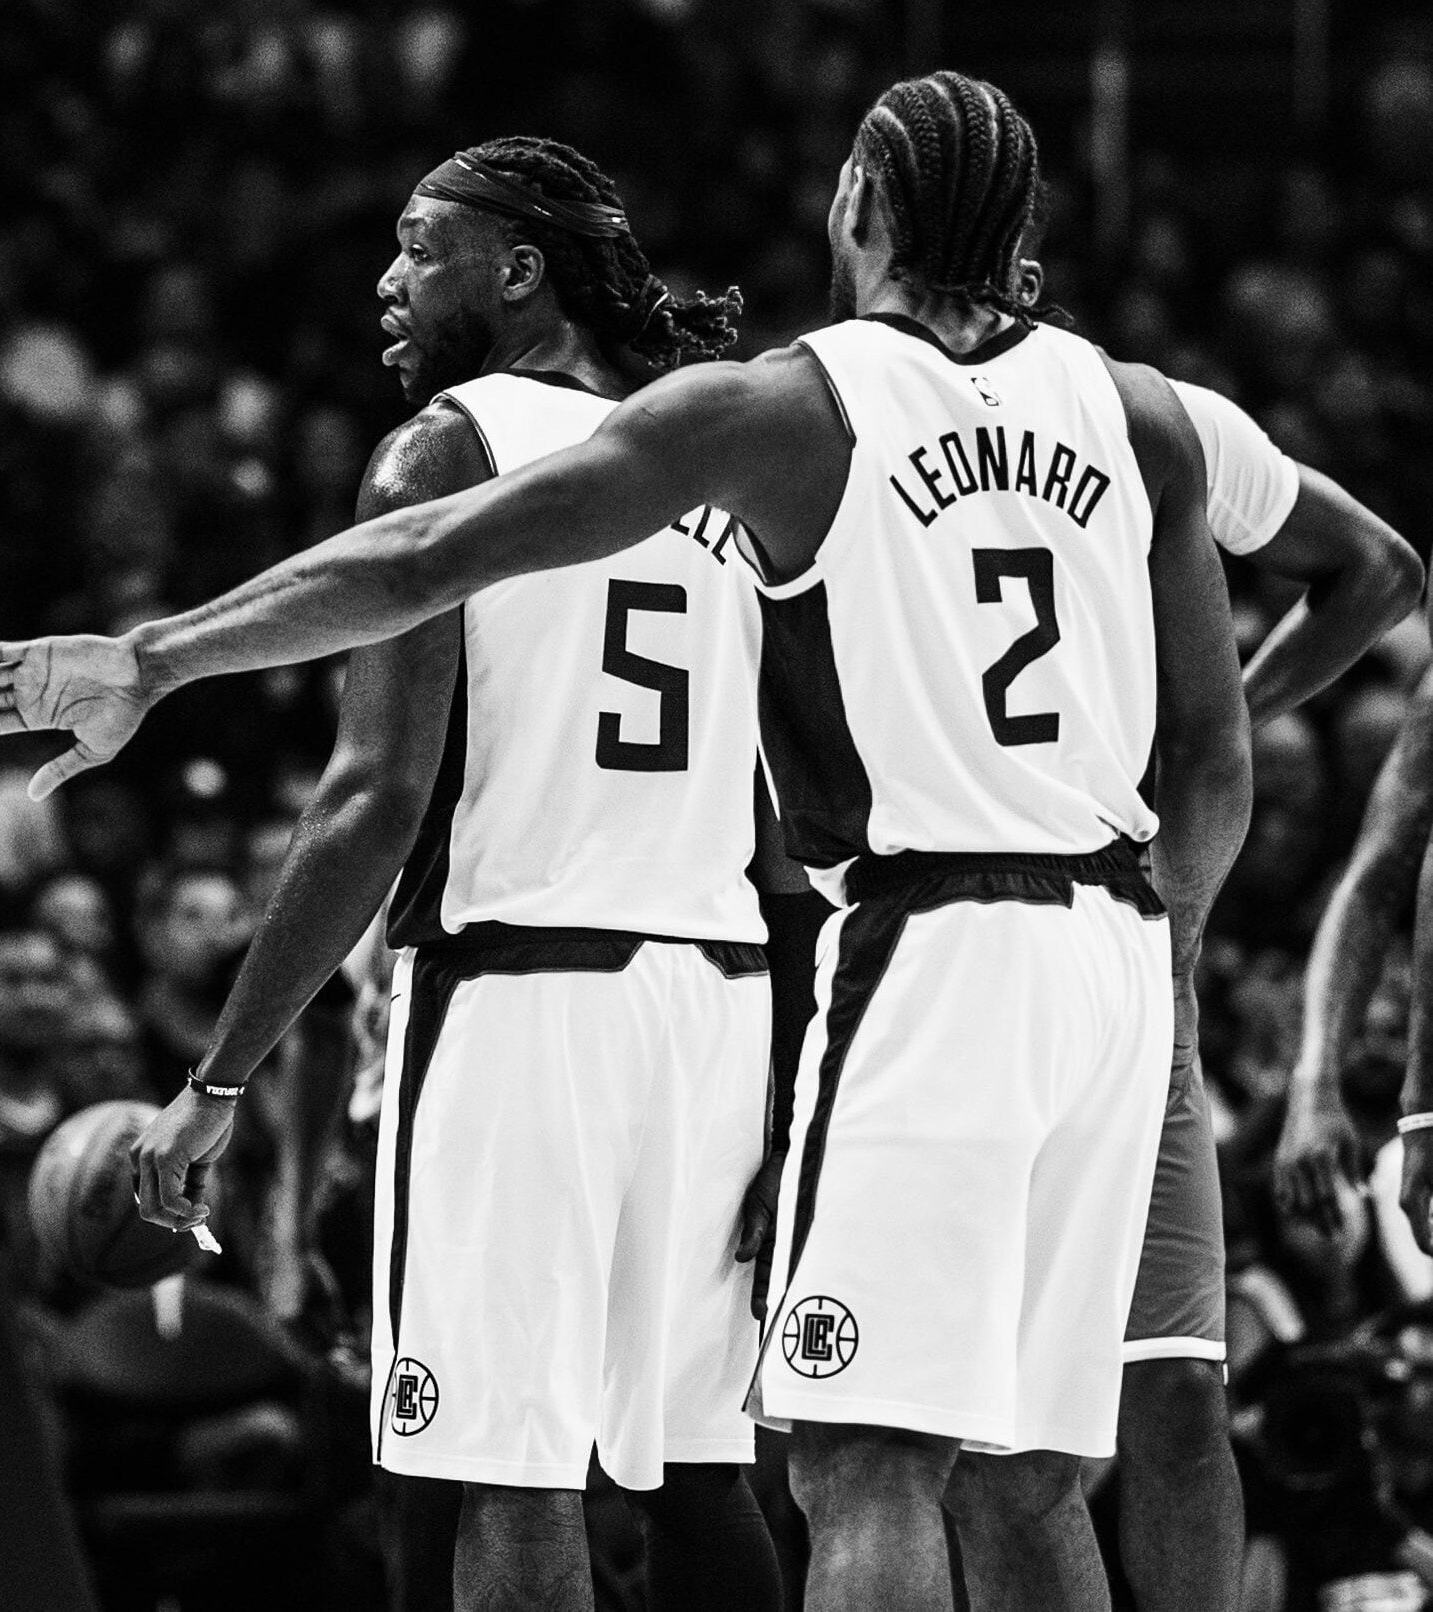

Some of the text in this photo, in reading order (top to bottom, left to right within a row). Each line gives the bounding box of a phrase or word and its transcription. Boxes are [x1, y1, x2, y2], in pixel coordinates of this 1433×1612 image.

[889, 426, 1111, 528] LEONARD
[595, 578, 689, 772] 5
[972, 547, 1061, 747] 2
